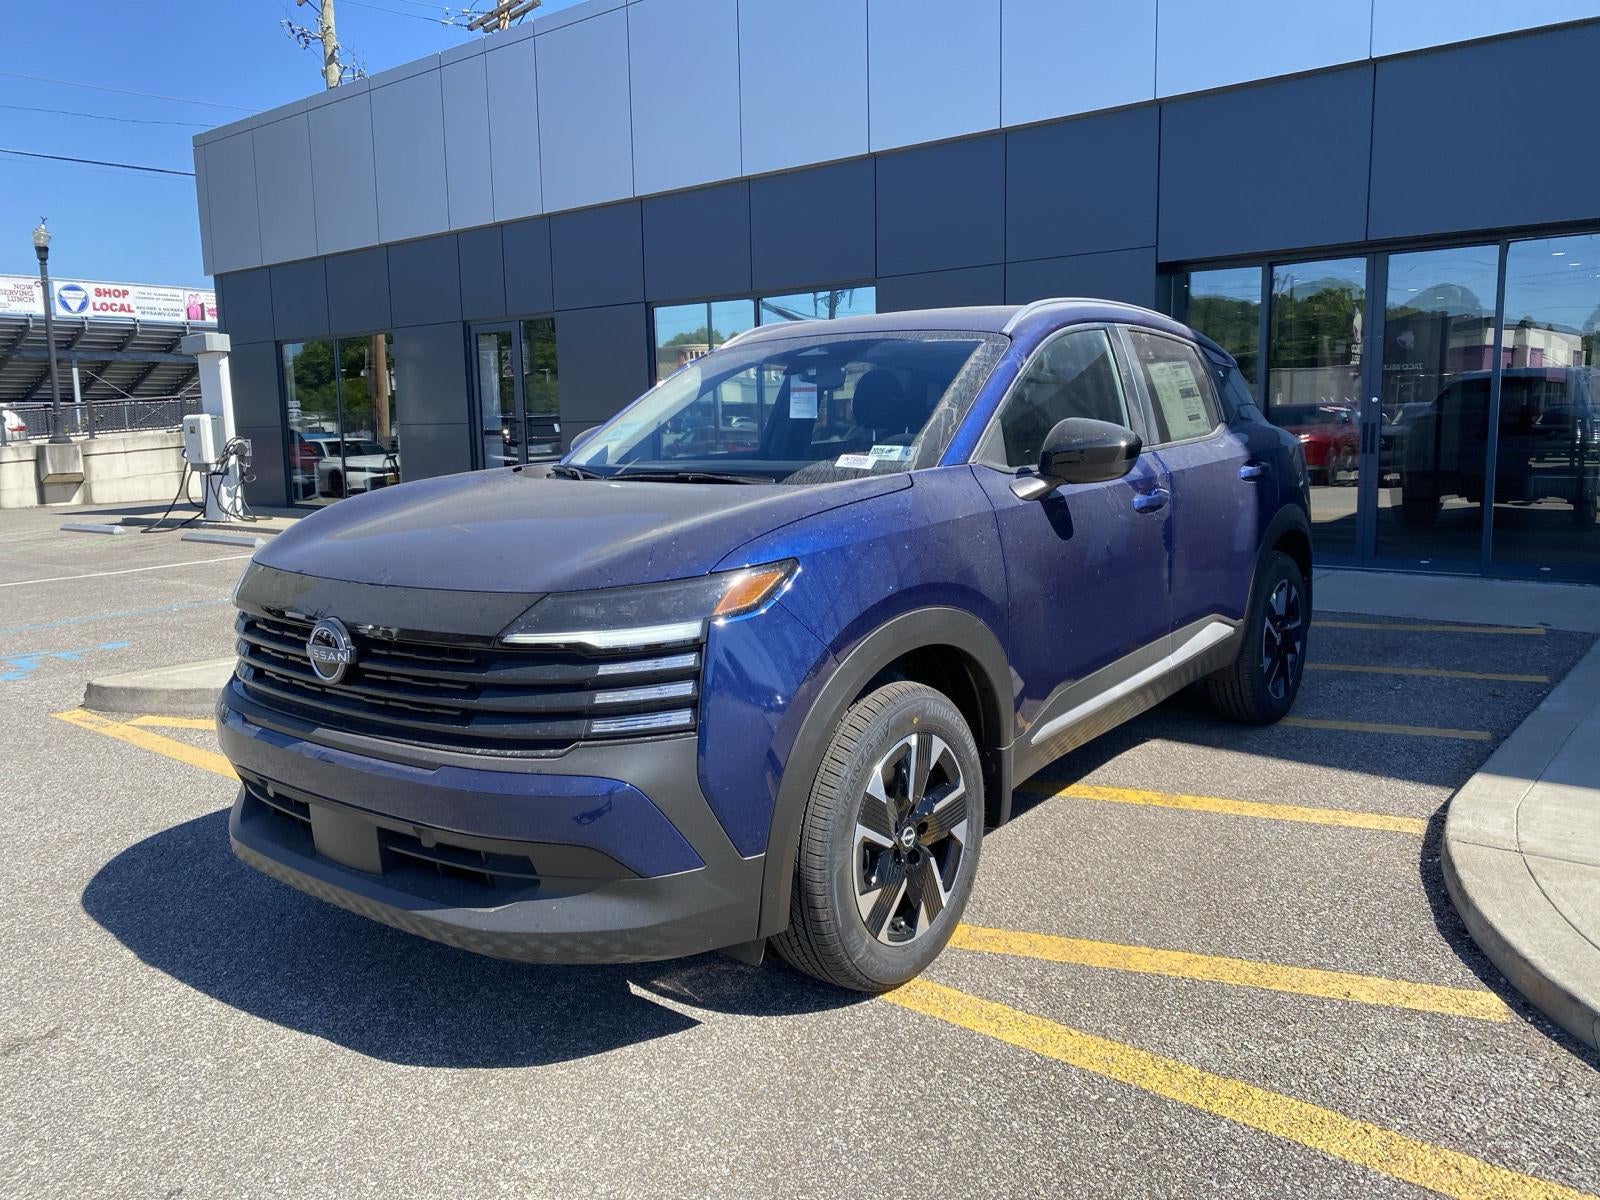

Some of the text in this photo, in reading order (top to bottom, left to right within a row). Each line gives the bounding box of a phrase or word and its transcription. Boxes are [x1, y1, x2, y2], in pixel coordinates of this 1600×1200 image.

[94, 287, 129, 298] SHOP
[7, 295, 35, 303] LUNCH
[92, 301, 135, 313] LOCAL
[309, 647, 347, 662] SSAN
